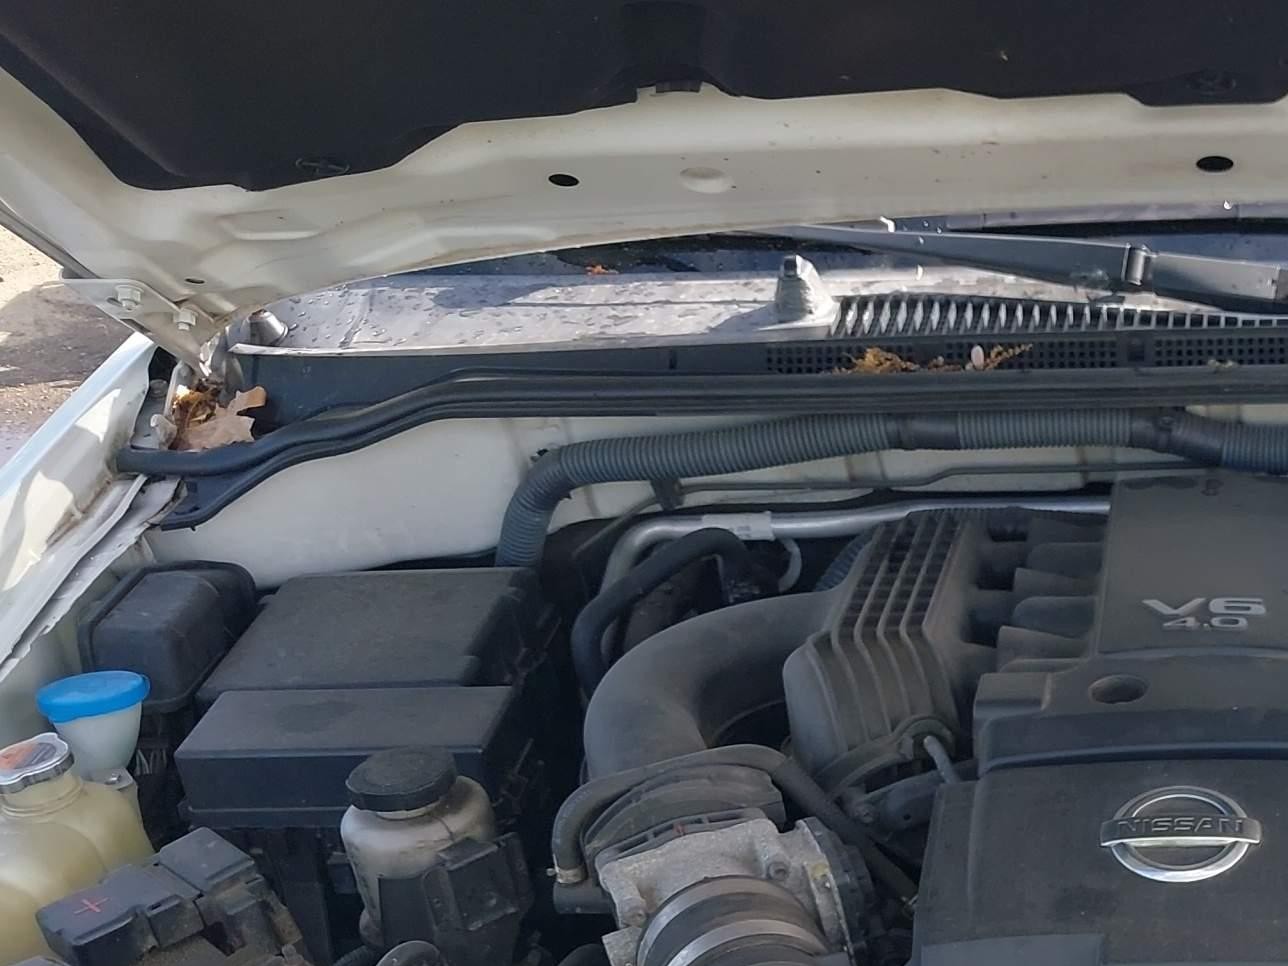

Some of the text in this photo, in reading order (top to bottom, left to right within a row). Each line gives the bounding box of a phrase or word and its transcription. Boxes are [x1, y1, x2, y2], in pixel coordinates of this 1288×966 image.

[1142, 597, 1267, 616] V6
[1162, 616, 1249, 630] 4.0
[1117, 816, 1243, 834] NISSAN
